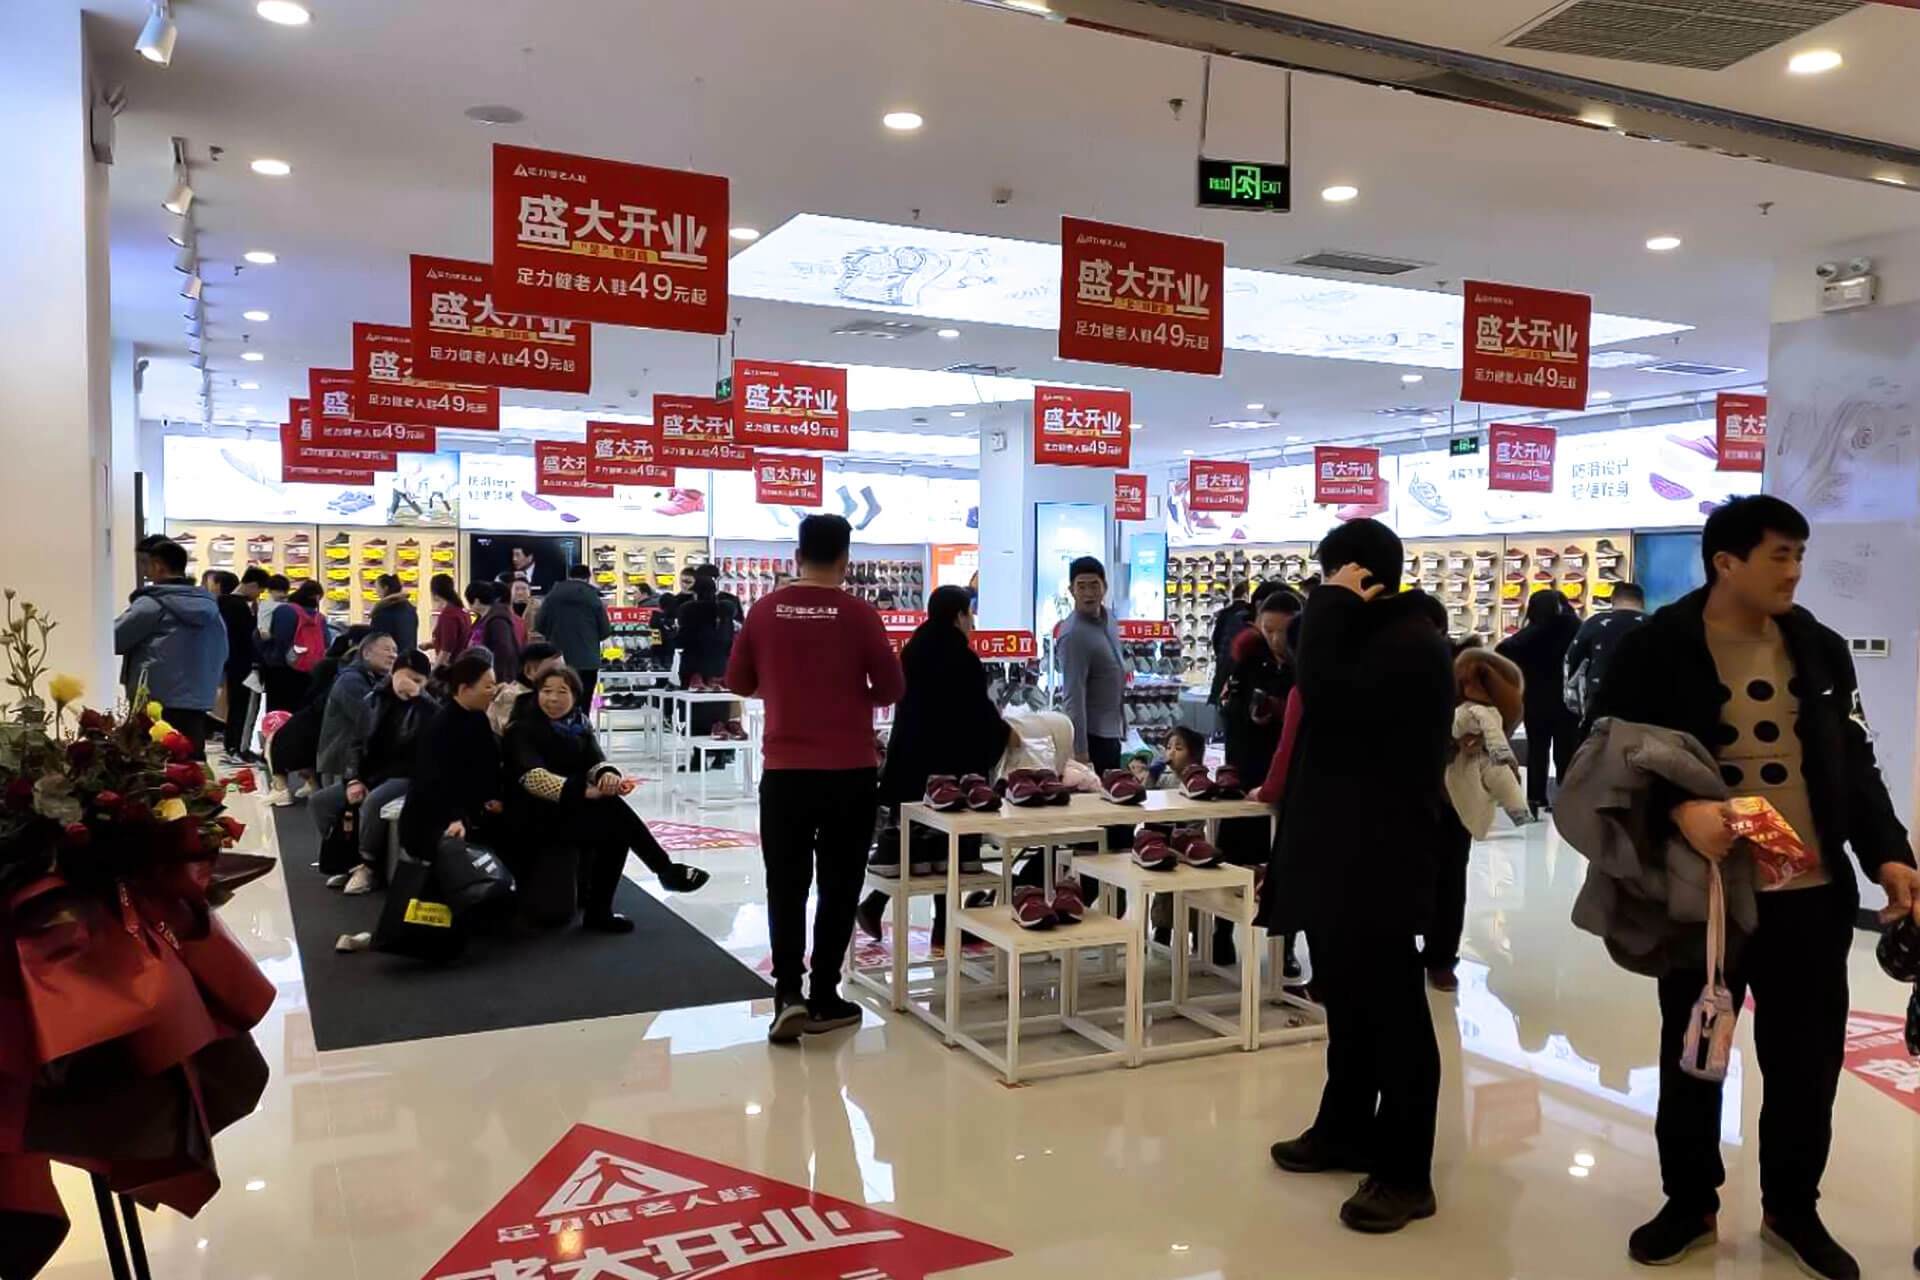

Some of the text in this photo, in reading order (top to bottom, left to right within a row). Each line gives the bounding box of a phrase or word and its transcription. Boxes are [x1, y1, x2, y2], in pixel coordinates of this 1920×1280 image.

[1262, 181, 1281, 194] EXIT
[516, 194, 708, 264] 盛大开业
[516, 267, 708, 306] 足力健老人鞋49元起
[1077, 258, 1210, 315] 盛大开业
[1076, 321, 1209, 351] 足力健老人鞋49元起
[1475, 314, 1578, 360] 盛大开业
[429, 346, 576, 373] 足力健老人鞋49元起
[744, 383, 839, 415] 盛大开业
[1043, 407, 1122, 435] 盛大开业
[595, 438, 654, 459] 盛大开
[1496, 440, 1551, 465] 盛大开业
[761, 466, 817, 486] 盛大开业
[1195, 473, 1244, 492] 盛大开业
[1321, 461, 1374, 481] 盛大开业
